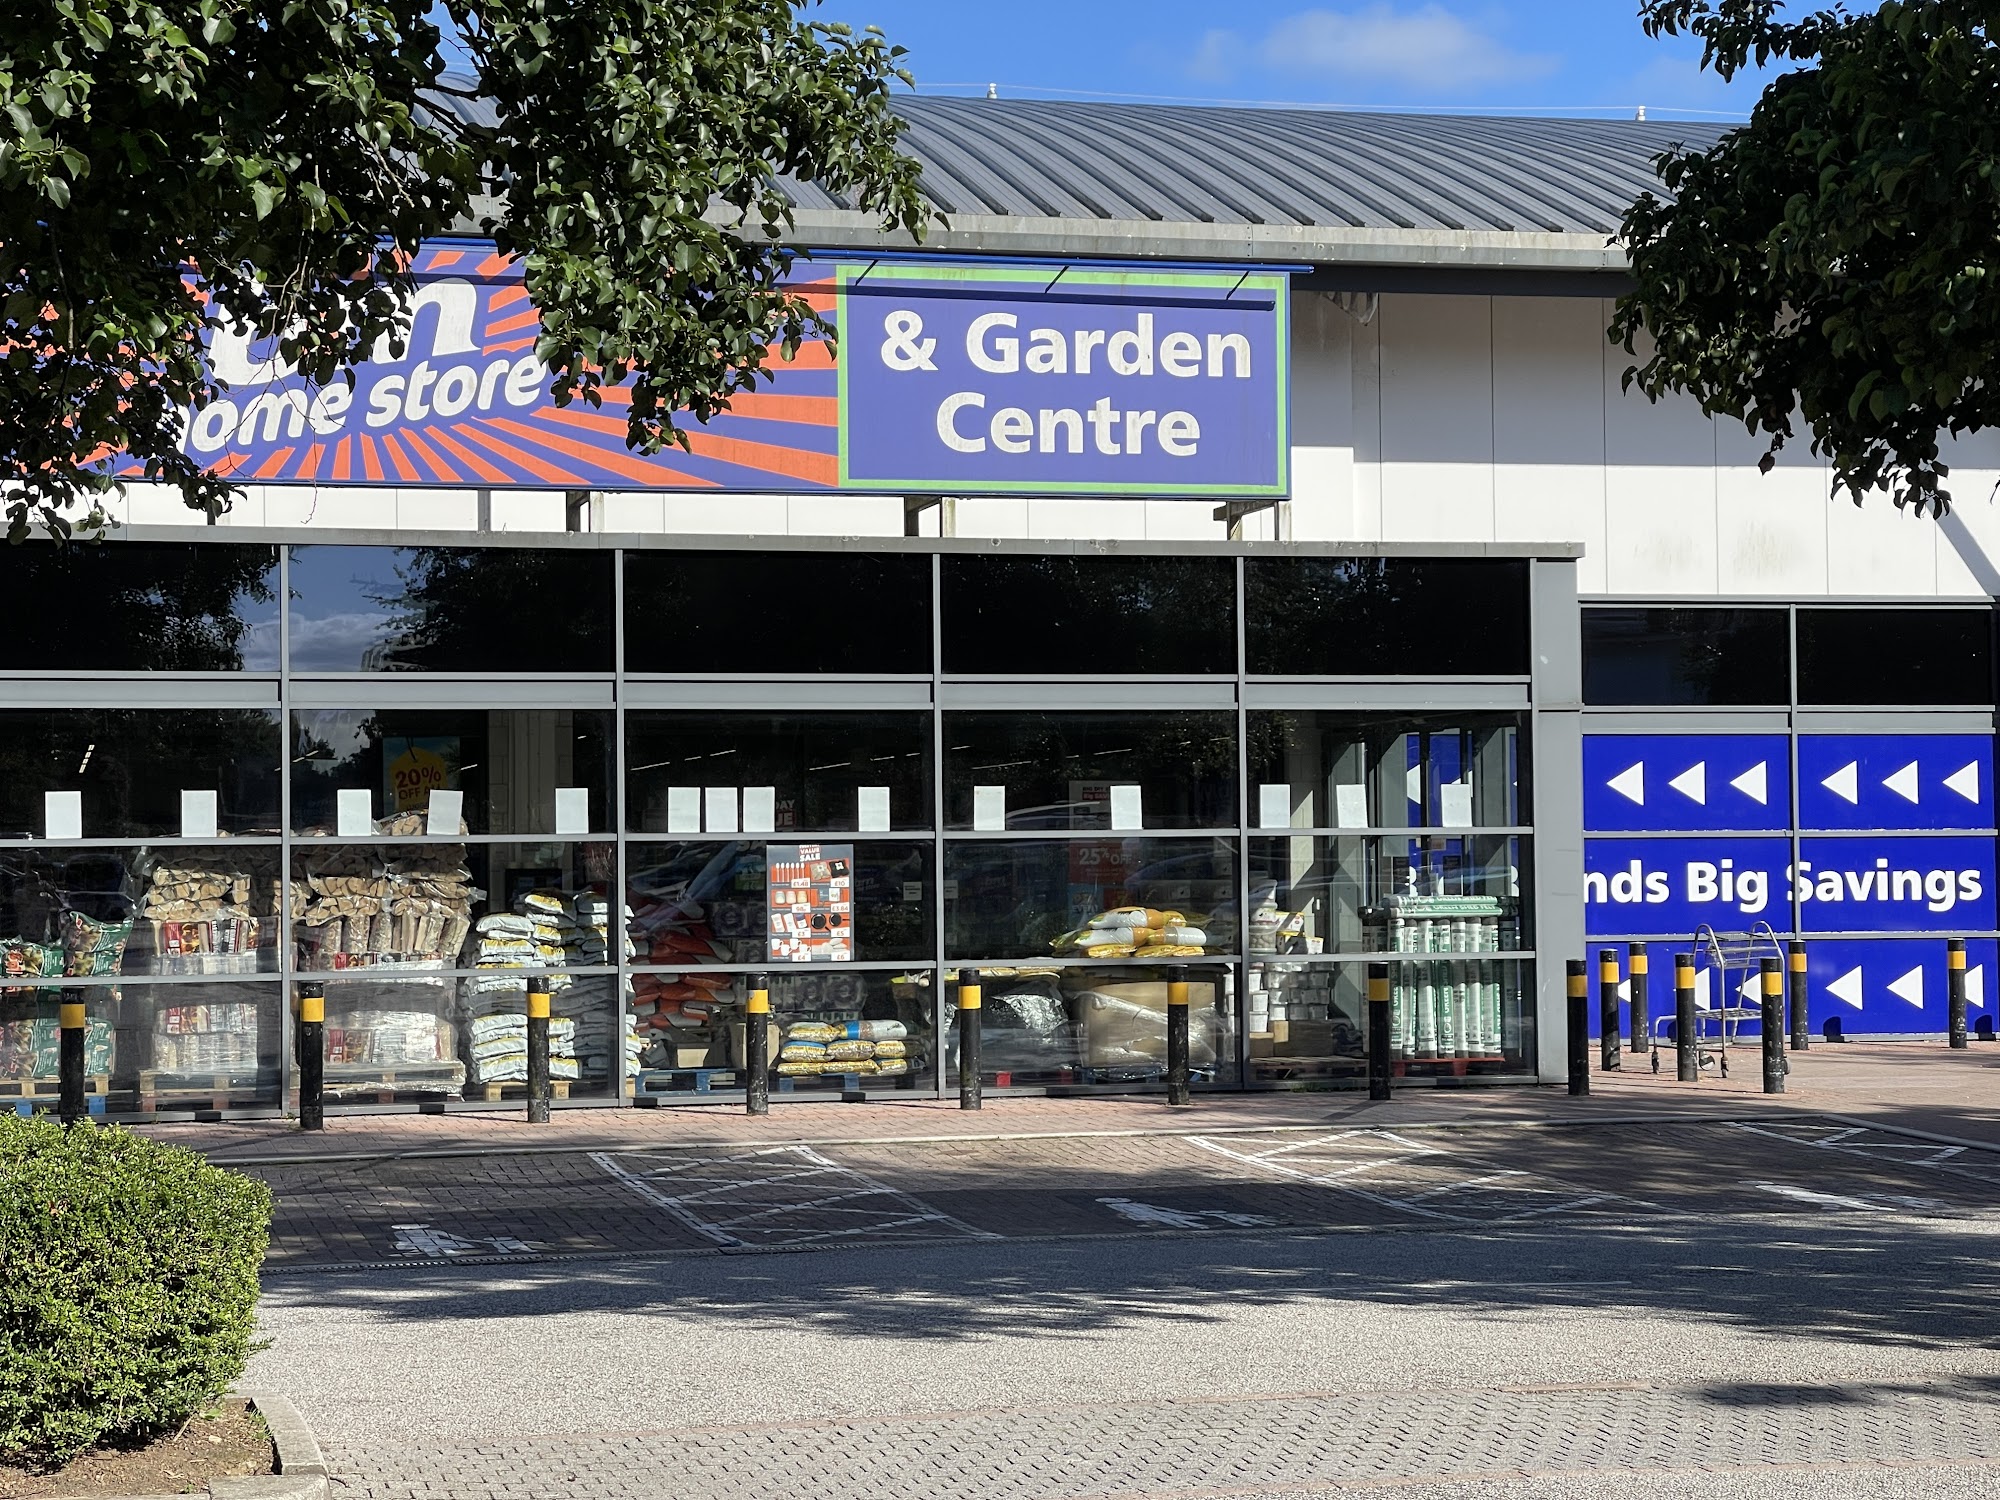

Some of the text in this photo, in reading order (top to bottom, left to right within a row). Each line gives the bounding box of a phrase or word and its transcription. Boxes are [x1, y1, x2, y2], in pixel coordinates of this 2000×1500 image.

[880, 309, 1252, 379] & Garden
[365, 354, 548, 428] store
[935, 391, 1201, 457] Centre
[396, 767, 441, 788] 20%
[398, 787, 421, 800] OFF
[799, 853, 821, 862] SALE
[800, 847, 820, 855] VALUE
[1079, 847, 1110, 865] 25%
[1686, 858, 1769, 914] Big
[1786, 857, 1983, 913] Savings
